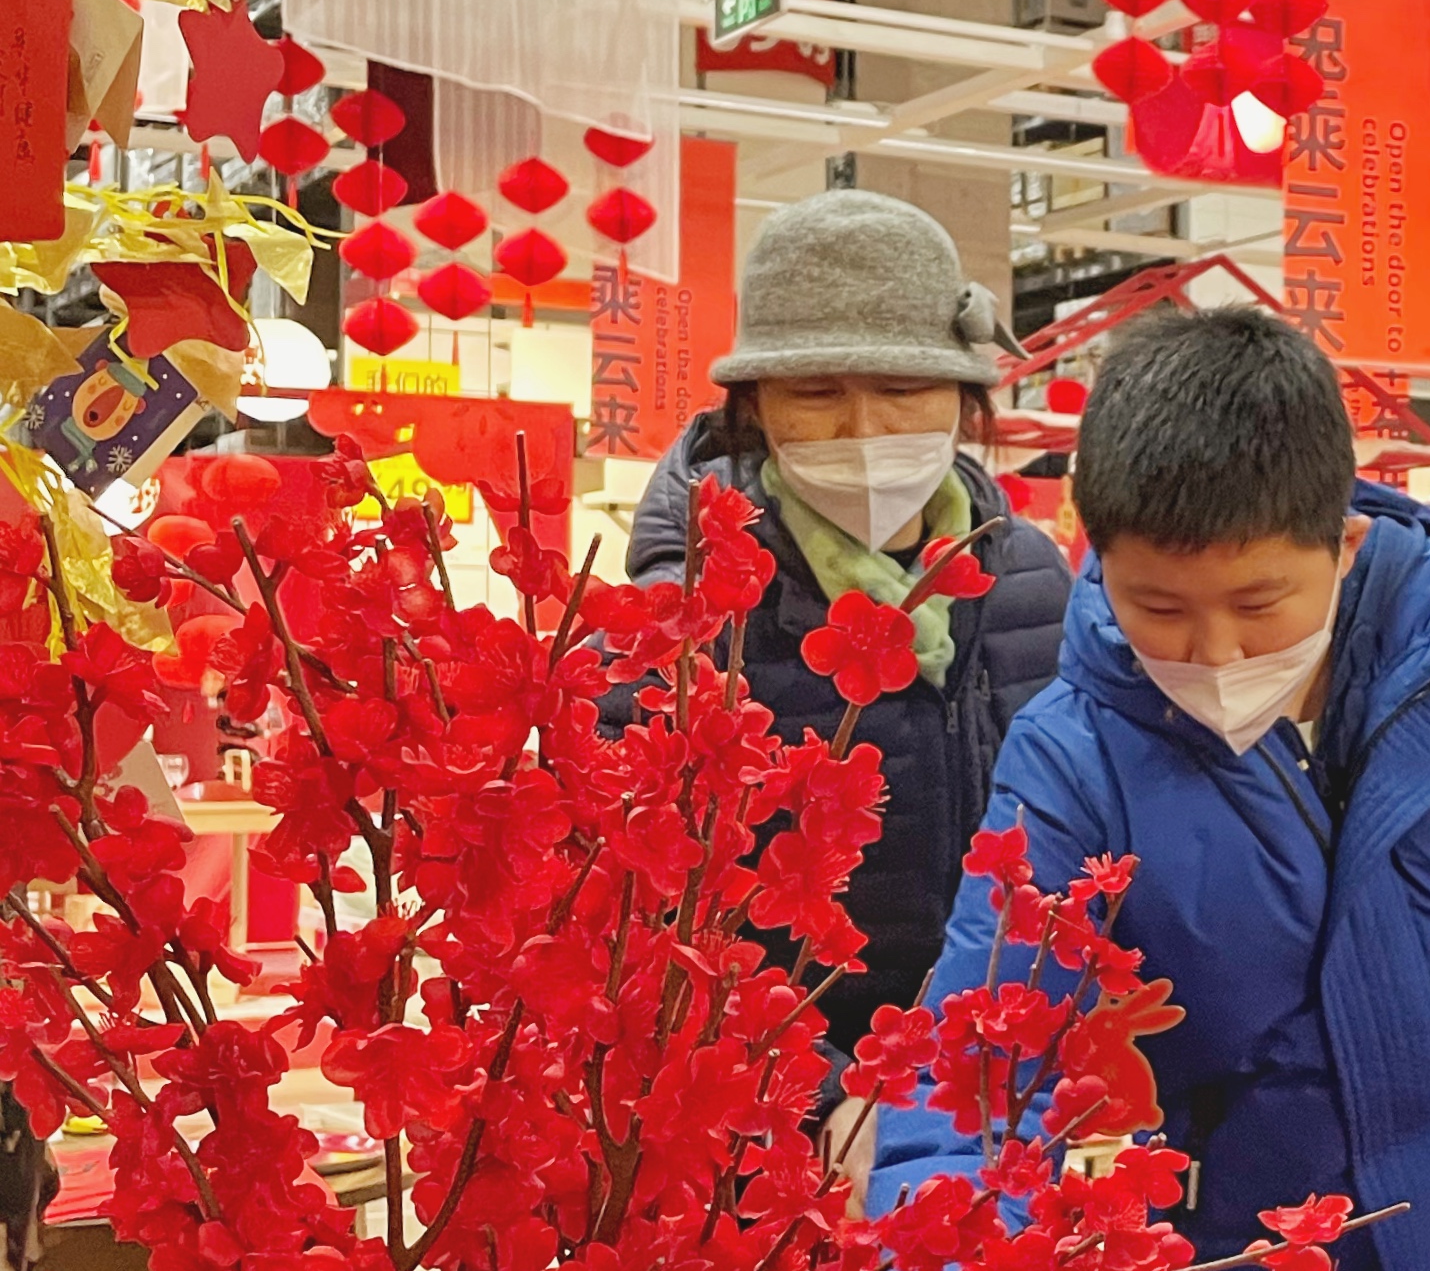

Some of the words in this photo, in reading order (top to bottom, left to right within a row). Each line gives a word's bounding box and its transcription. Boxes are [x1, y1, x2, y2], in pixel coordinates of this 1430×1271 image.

[1384, 122, 1406, 194] Open
[1361, 118, 1380, 287] celebrations
[1388, 203, 1406, 247] the
[1388, 254, 1406, 318] door
[675, 289, 692, 342] Open
[1387, 326, 1404, 353] to
[655, 286, 671, 411] celebrations
[676, 346, 692, 382] the
